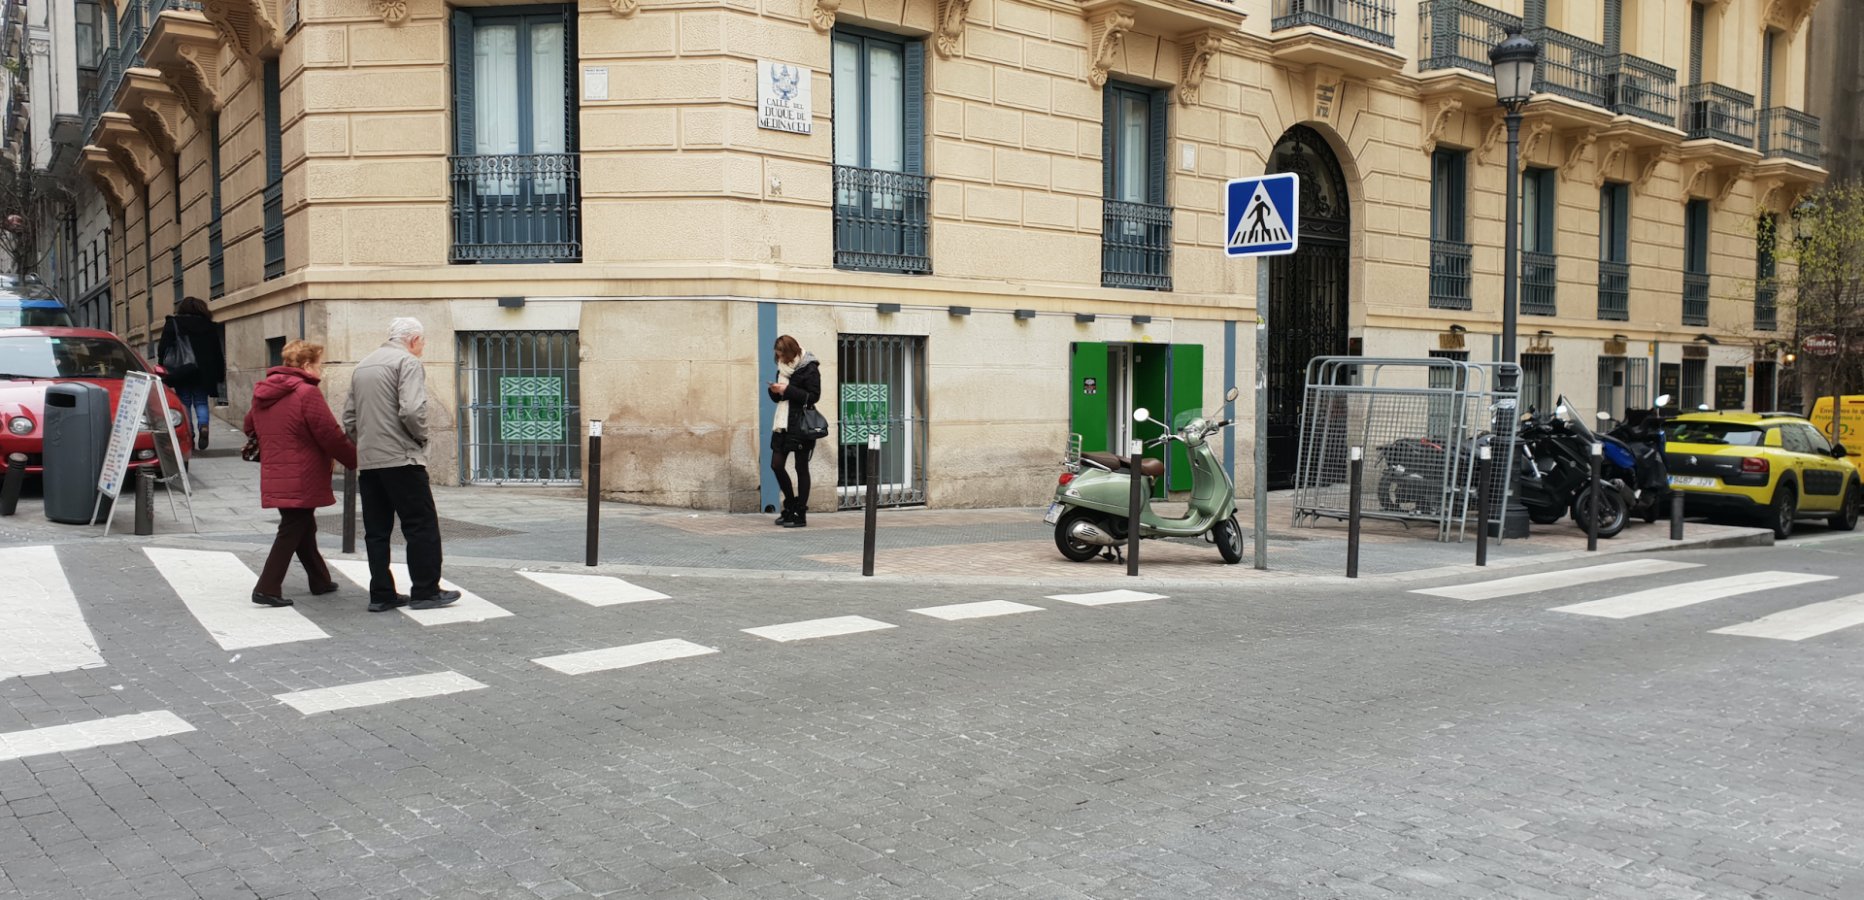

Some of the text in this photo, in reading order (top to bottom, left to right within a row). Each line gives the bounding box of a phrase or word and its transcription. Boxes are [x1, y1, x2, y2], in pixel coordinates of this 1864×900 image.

[767, 98, 789, 108] CALLE
[765, 106, 806, 121] DUQUE DE
[760, 117, 812, 133] MEDINACELI
[504, 408, 559, 420] MEXCO
